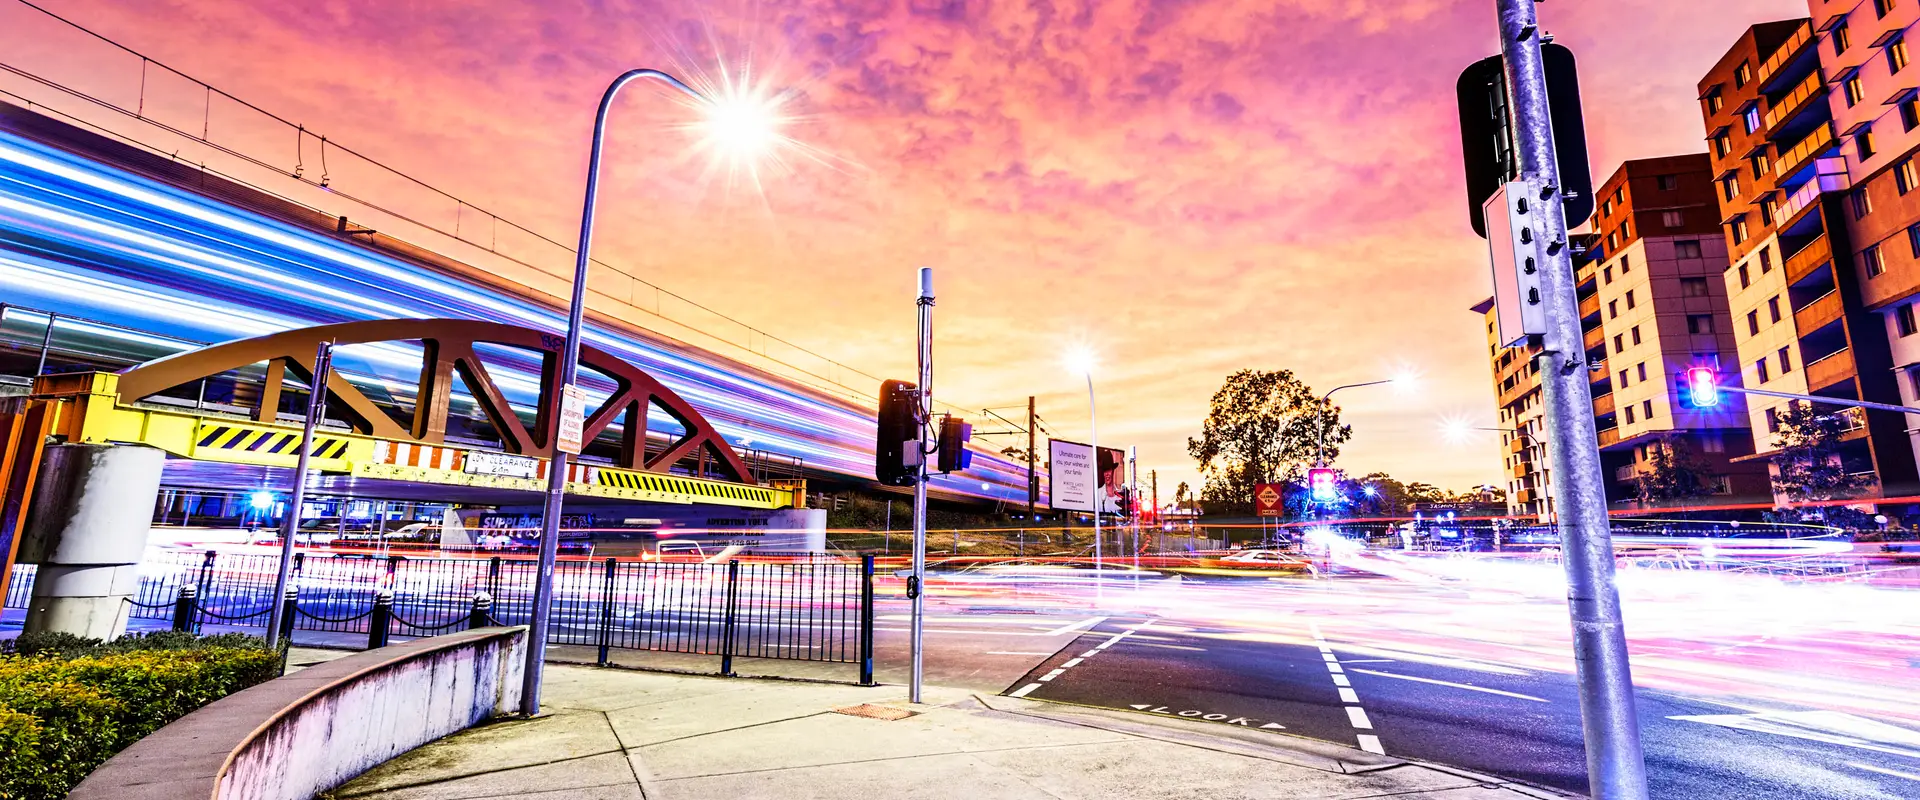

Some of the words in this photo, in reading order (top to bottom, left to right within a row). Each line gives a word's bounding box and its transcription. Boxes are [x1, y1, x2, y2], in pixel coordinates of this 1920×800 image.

[1058, 450, 1074, 458] Ultimate
[472, 454, 485, 463] LOW
[489, 456, 533, 469] CLEARANCE
[1072, 468, 1083, 477] family
[482, 516, 543, 529] SUPPLEME
[706, 518, 746, 526] ADVERTISE
[748, 518, 768, 526] YOUR
[1150, 706, 1256, 726] LOOK
